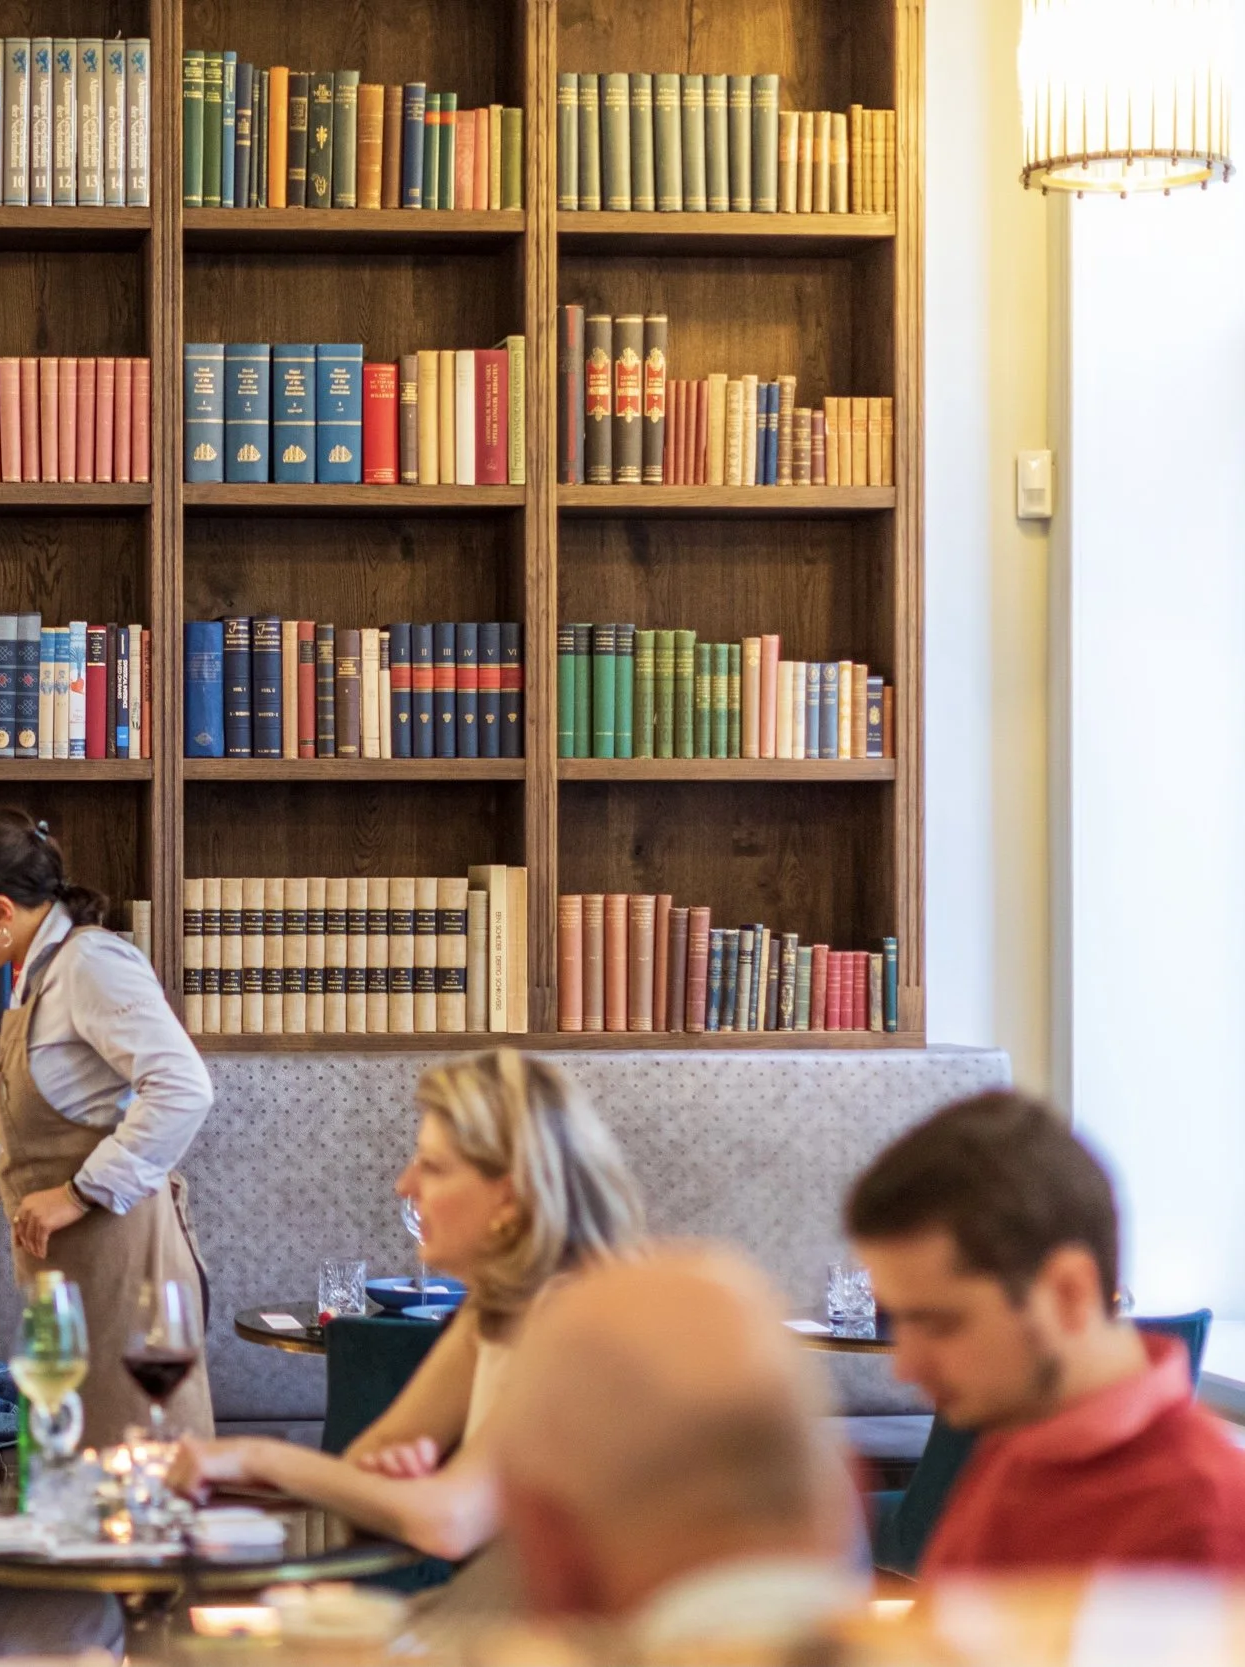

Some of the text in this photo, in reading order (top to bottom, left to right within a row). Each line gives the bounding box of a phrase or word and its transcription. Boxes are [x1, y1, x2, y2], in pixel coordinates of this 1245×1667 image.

[12, 176, 24, 188] 10
[35, 176, 46, 188] 11
[58, 176, 71, 188] 12
[85, 175, 98, 187] 13
[133, 176, 145, 189] 15
[401, 648, 404, 656] I
[421, 648, 427, 656] II
[443, 648, 451, 656] III
[463, 649, 473, 657] IV
[507, 648, 517, 656] VI
